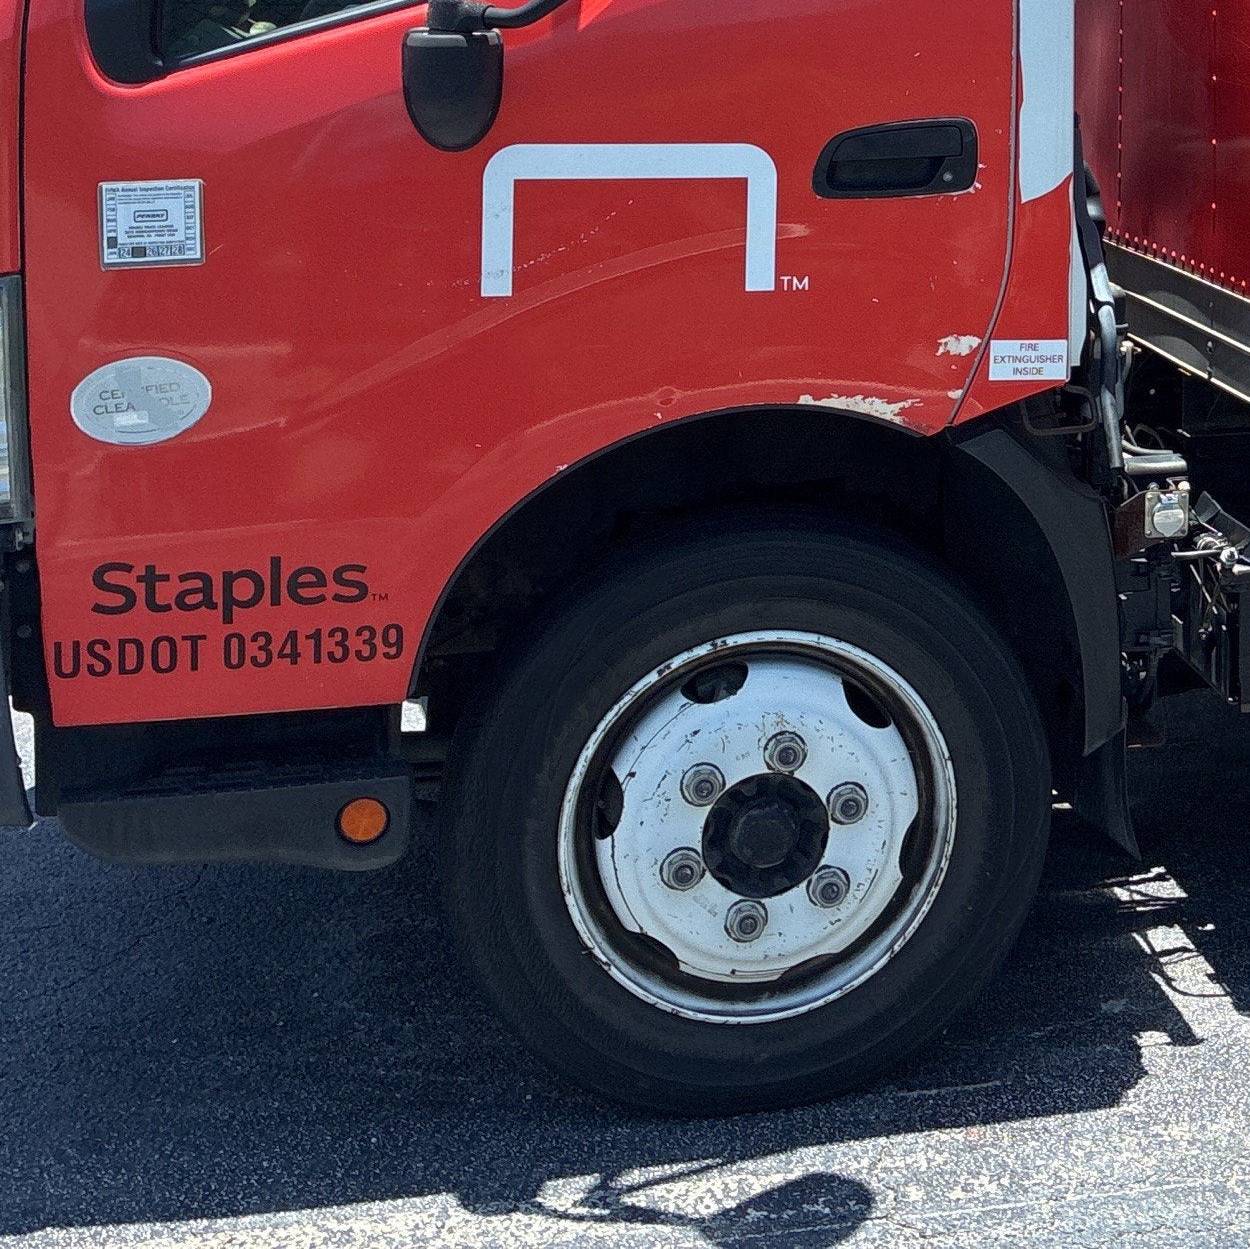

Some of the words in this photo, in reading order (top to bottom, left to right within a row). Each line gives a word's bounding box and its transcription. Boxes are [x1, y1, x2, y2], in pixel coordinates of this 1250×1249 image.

[1019, 342, 1040, 352] FIRE
[993, 354, 1064, 364] EXTINGUISHER
[1012, 366, 1044, 376] INSIDE
[99, 381, 181, 402] CEFIED
[90, 556, 370, 625] Staples
[53, 633, 207, 680] USDOT
[222, 623, 405, 671] 0341339
